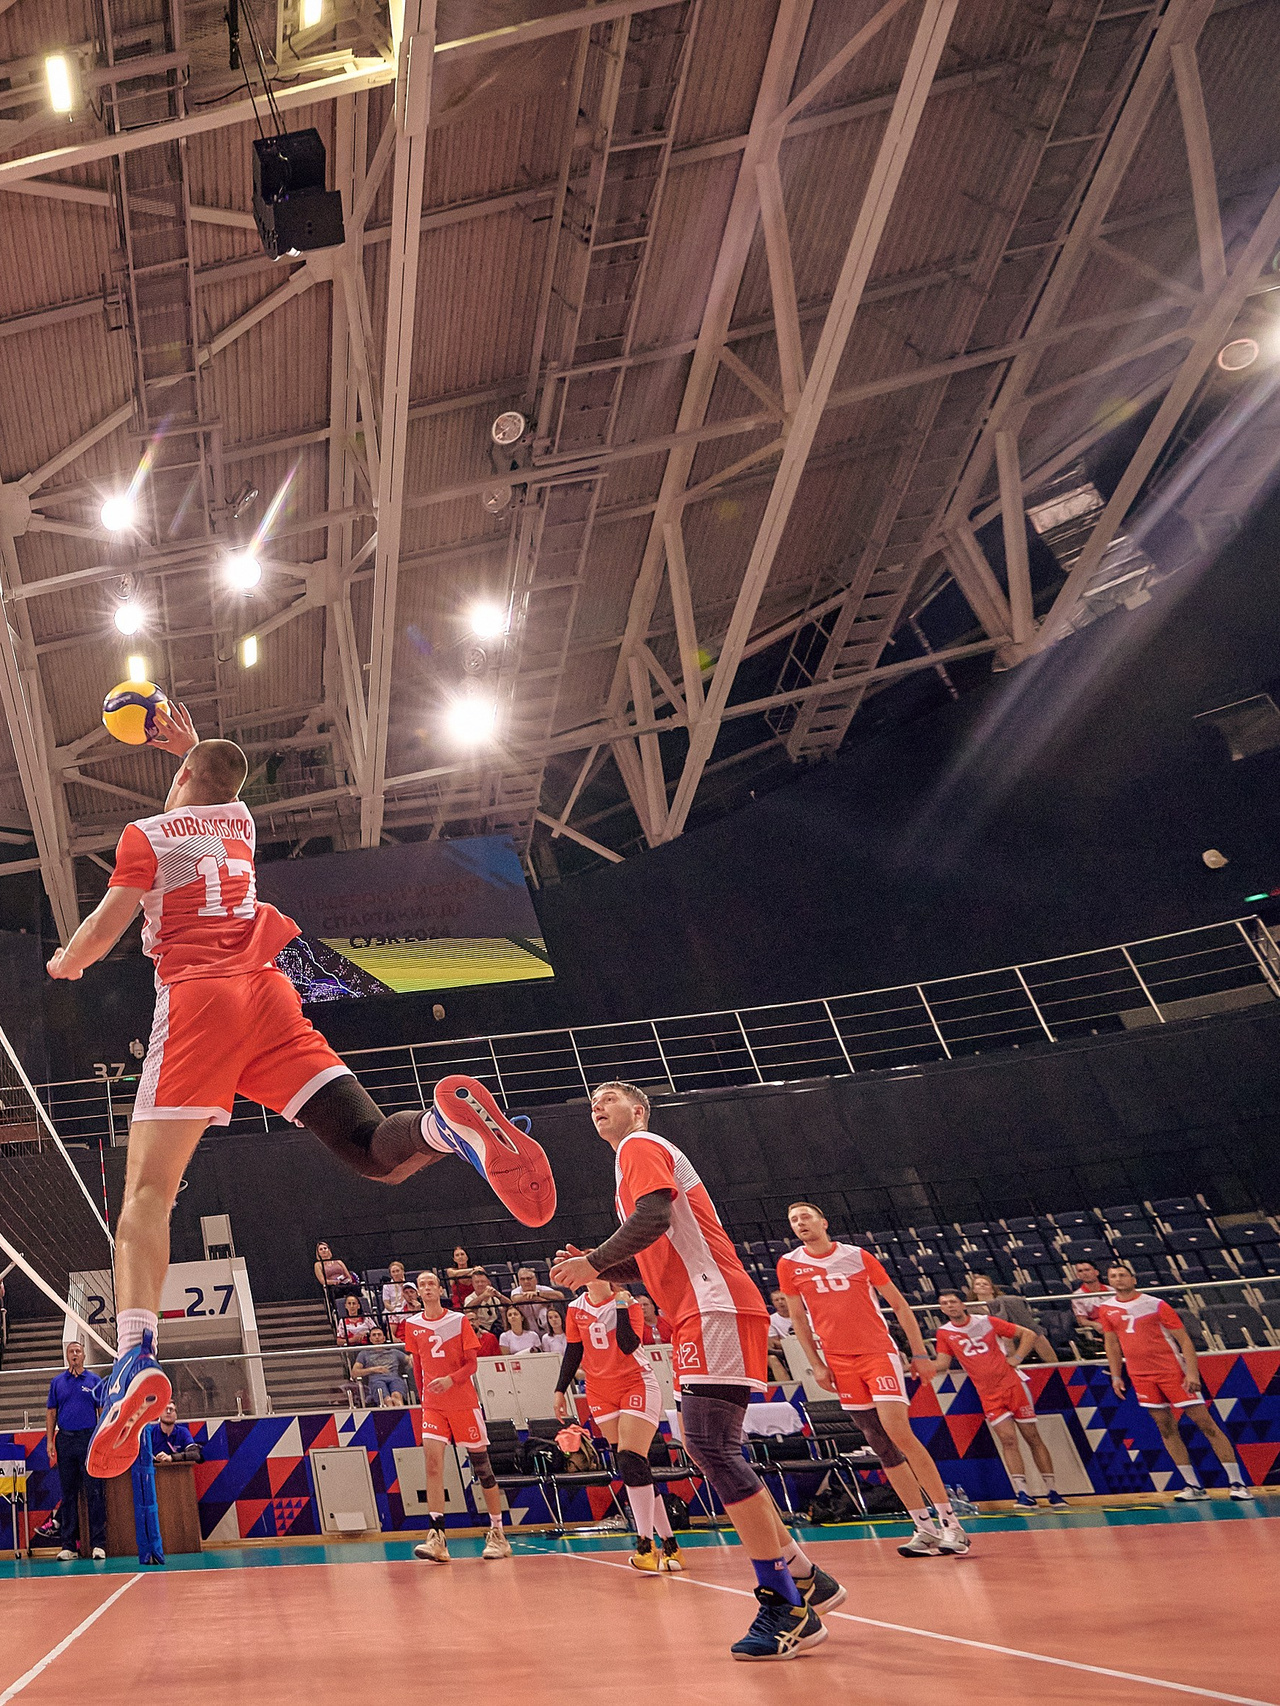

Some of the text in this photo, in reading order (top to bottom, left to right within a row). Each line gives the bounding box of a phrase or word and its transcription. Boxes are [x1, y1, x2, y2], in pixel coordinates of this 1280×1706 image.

[160, 816, 253, 840] НОВОСИБИРС
[195, 855, 256, 919] 17
[93, 1063, 126, 1083] 37
[811, 1273, 850, 1293] 10
[87, 1296, 116, 1325] 2.
[185, 1285, 234, 1317] 2.7
[1121, 1314, 1135, 1333] 7
[428, 1335, 445, 1358] 2
[588, 1322, 609, 1349] 8
[958, 1335, 989, 1357] 25
[677, 1342, 700, 1369] 12
[876, 1376, 898, 1391] 10
[629, 1394, 643, 1408] 8
[468, 1426, 480, 1440] 2
